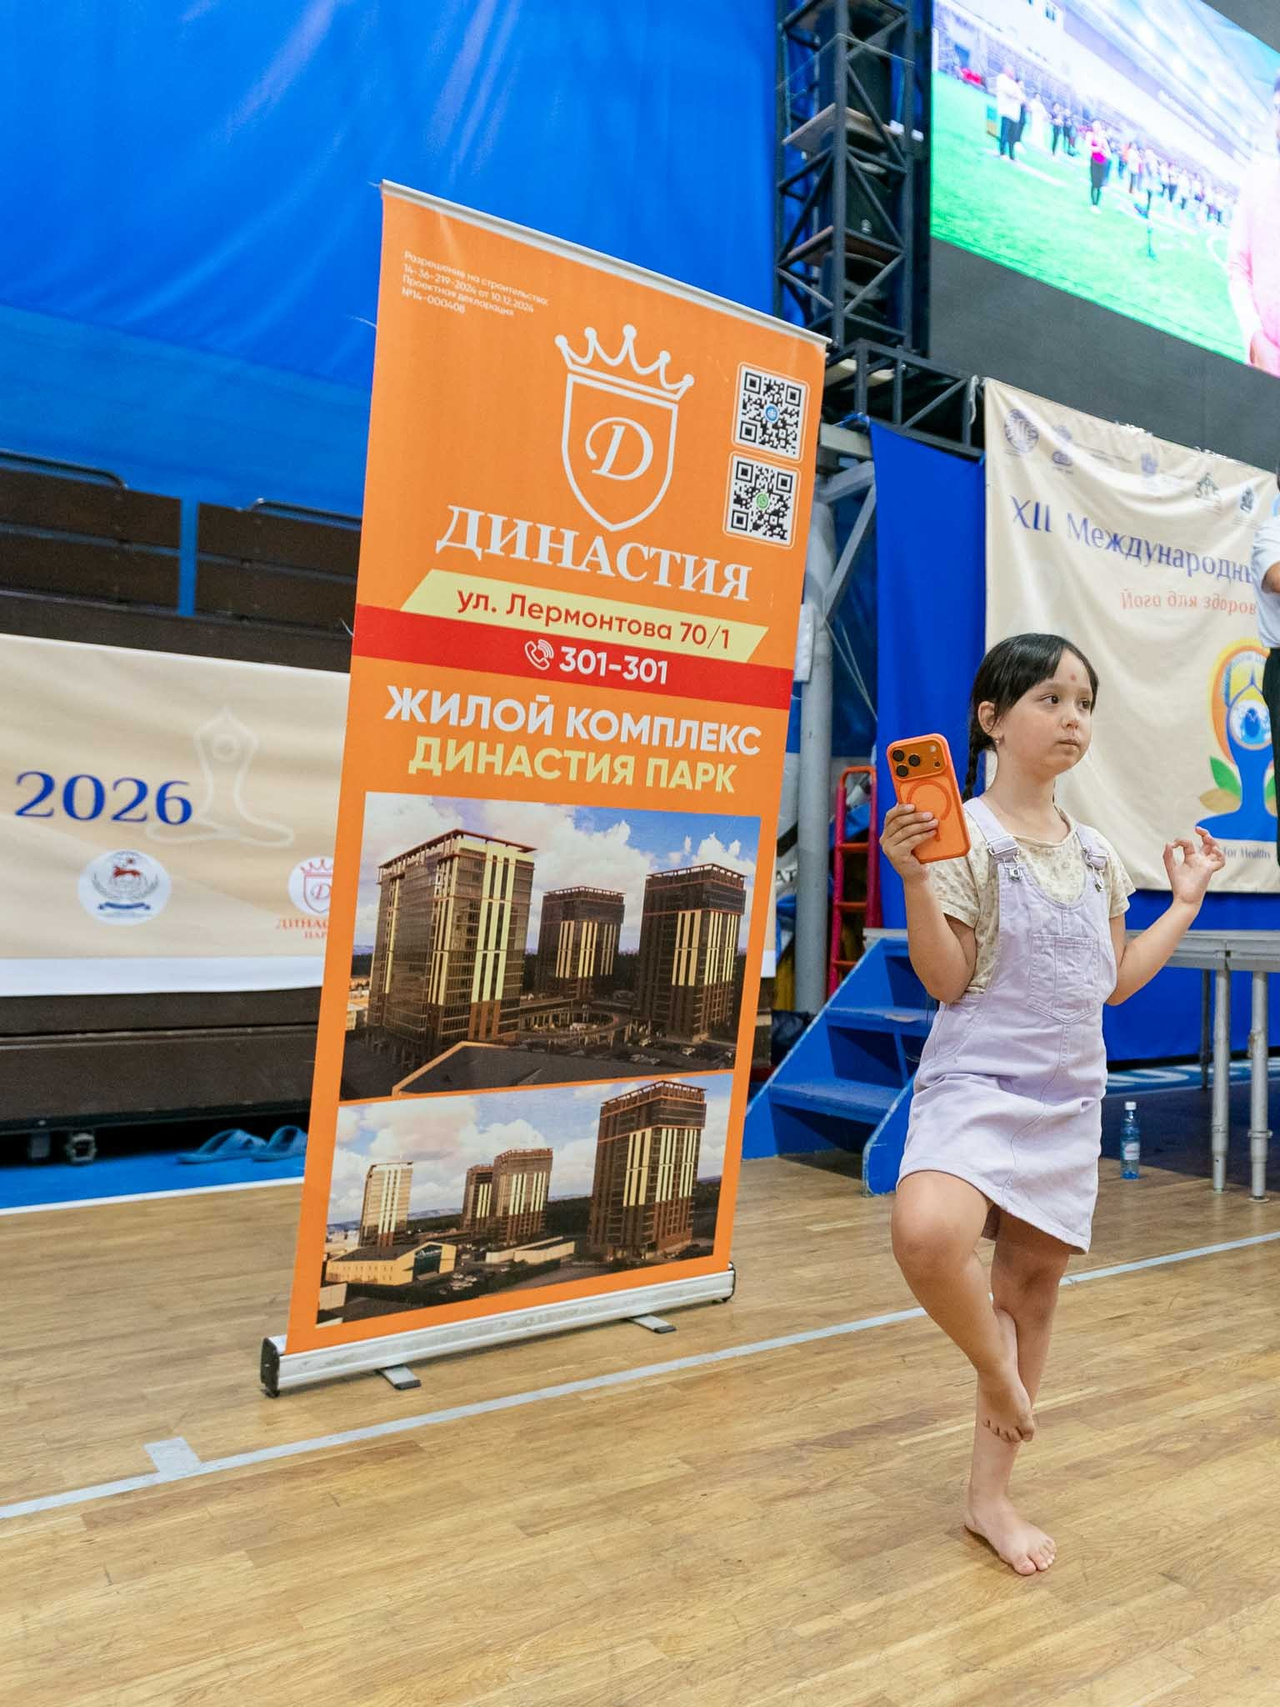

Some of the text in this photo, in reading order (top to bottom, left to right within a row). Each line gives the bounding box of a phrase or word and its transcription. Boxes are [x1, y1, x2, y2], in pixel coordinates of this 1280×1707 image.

[1010, 495, 1052, 532] XII
[436, 505, 752, 601] ДИНАСТИЯ
[457, 590, 730, 650] ул. Лермонтова 70/1
[1203, 592, 1257, 616] здоров
[559, 646, 668, 685] 301-301
[384, 685, 762, 756] ЖИЛОЙ КОМПЛЕКС
[408, 736, 737, 793] ДИНАСТИЯ ПАРК
[15, 770, 193, 826] 2026
